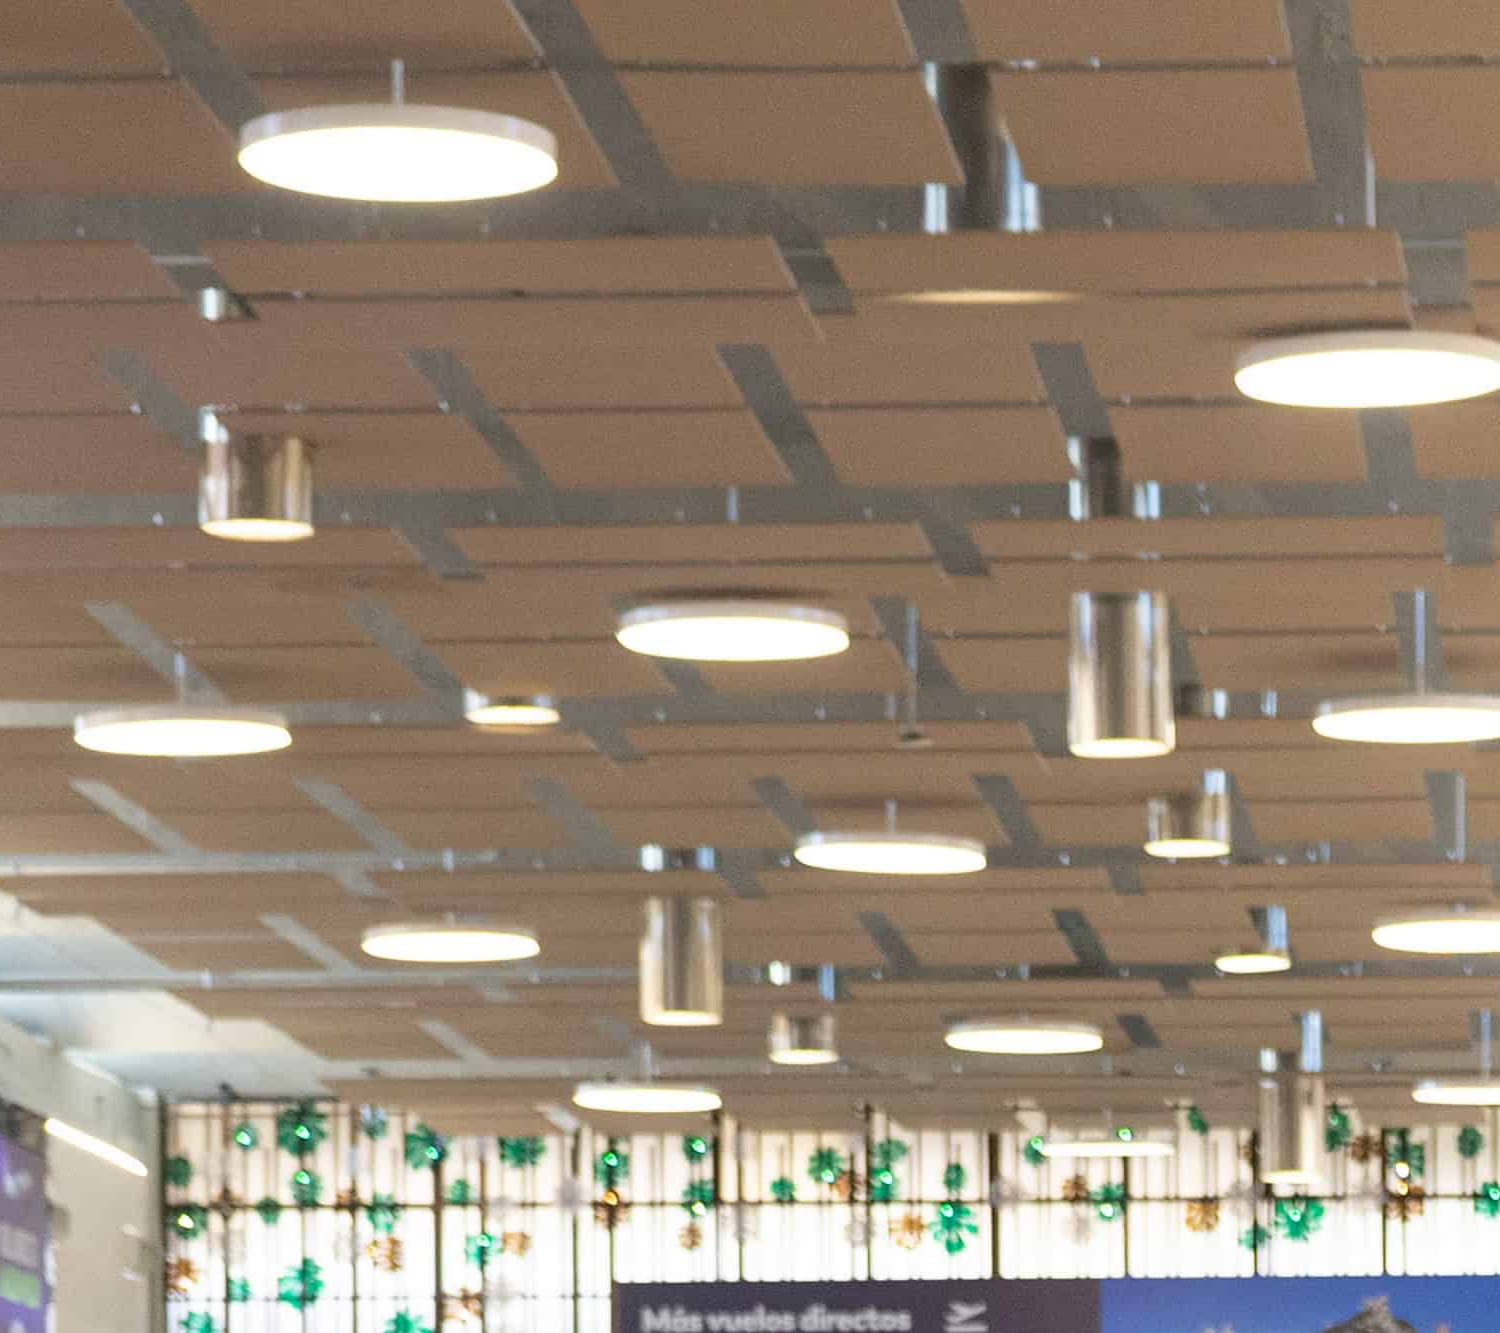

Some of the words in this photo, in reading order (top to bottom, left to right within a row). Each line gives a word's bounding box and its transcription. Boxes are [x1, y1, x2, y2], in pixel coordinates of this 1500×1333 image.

[640, 1304, 701, 1333] Más
[706, 1305, 795, 1333] vuelos
[800, 1305, 912, 1333] directos
